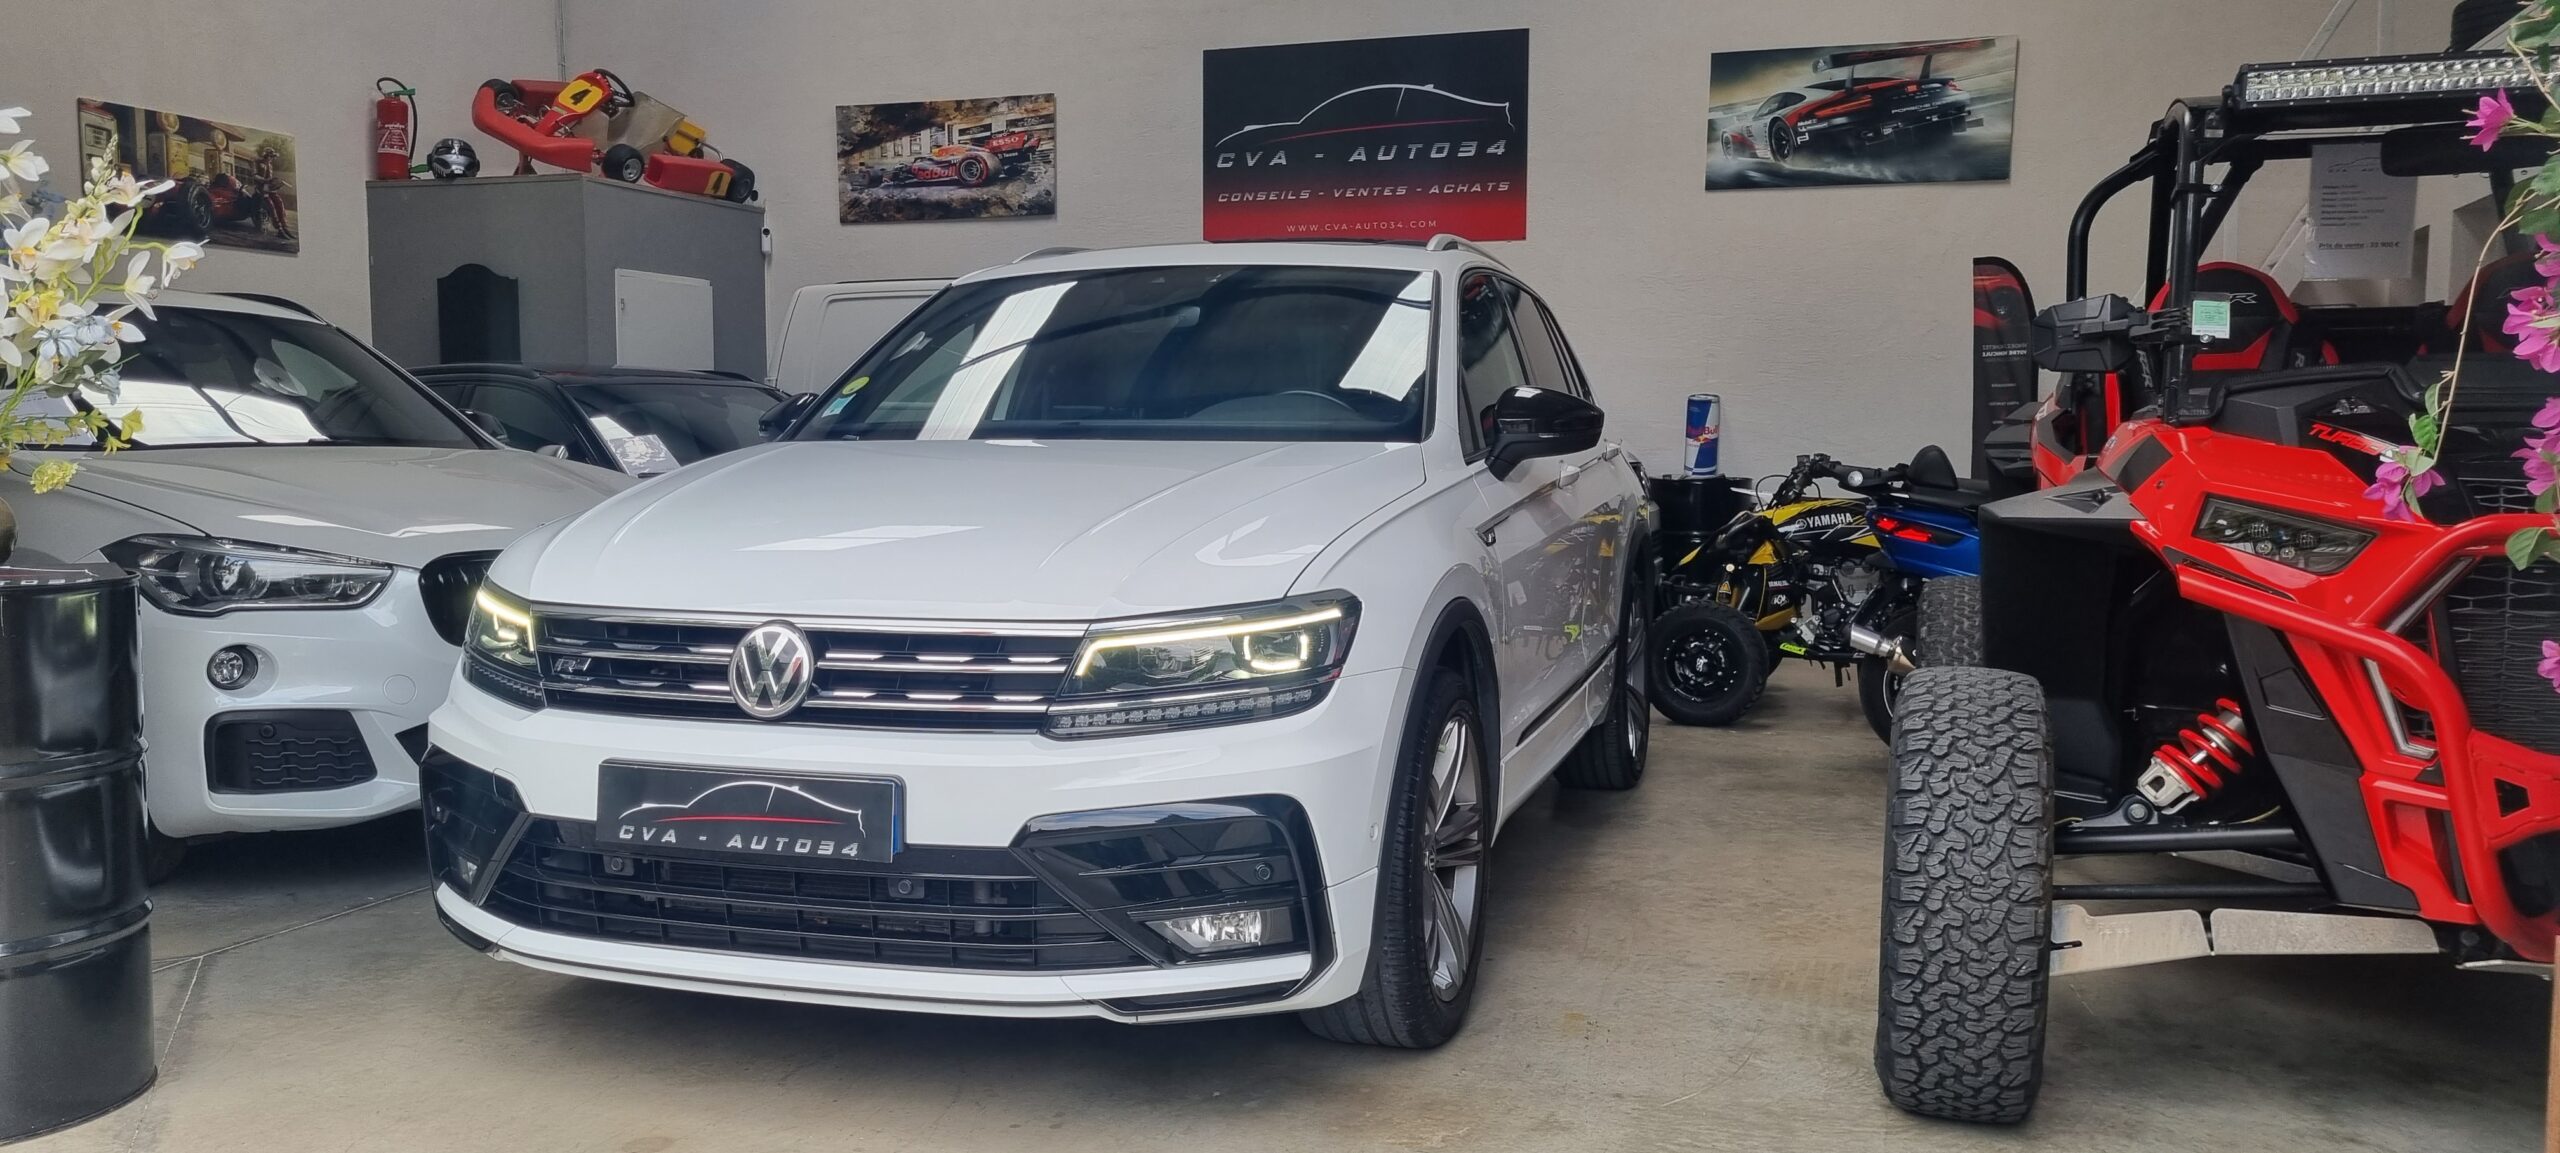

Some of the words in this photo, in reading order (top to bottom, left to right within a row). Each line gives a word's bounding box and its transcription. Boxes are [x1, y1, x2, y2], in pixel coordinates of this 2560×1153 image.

[569, 88, 592, 106] 4
[1216, 151, 1288, 168] CVA
[1348, 139, 1507, 162] AUTO34
[1218, 188, 1312, 202] CONSEILS
[1333, 185, 1408, 198] VENTES
[1429, 181, 1511, 195] ACHATS
[1286, 220, 1437, 232] WWW.CVA-AUTO34.COM
[1806, 512, 1853, 528] YAMAHA
[618, 824, 677, 844] CVA
[726, 833, 860, 858] AUTO34
